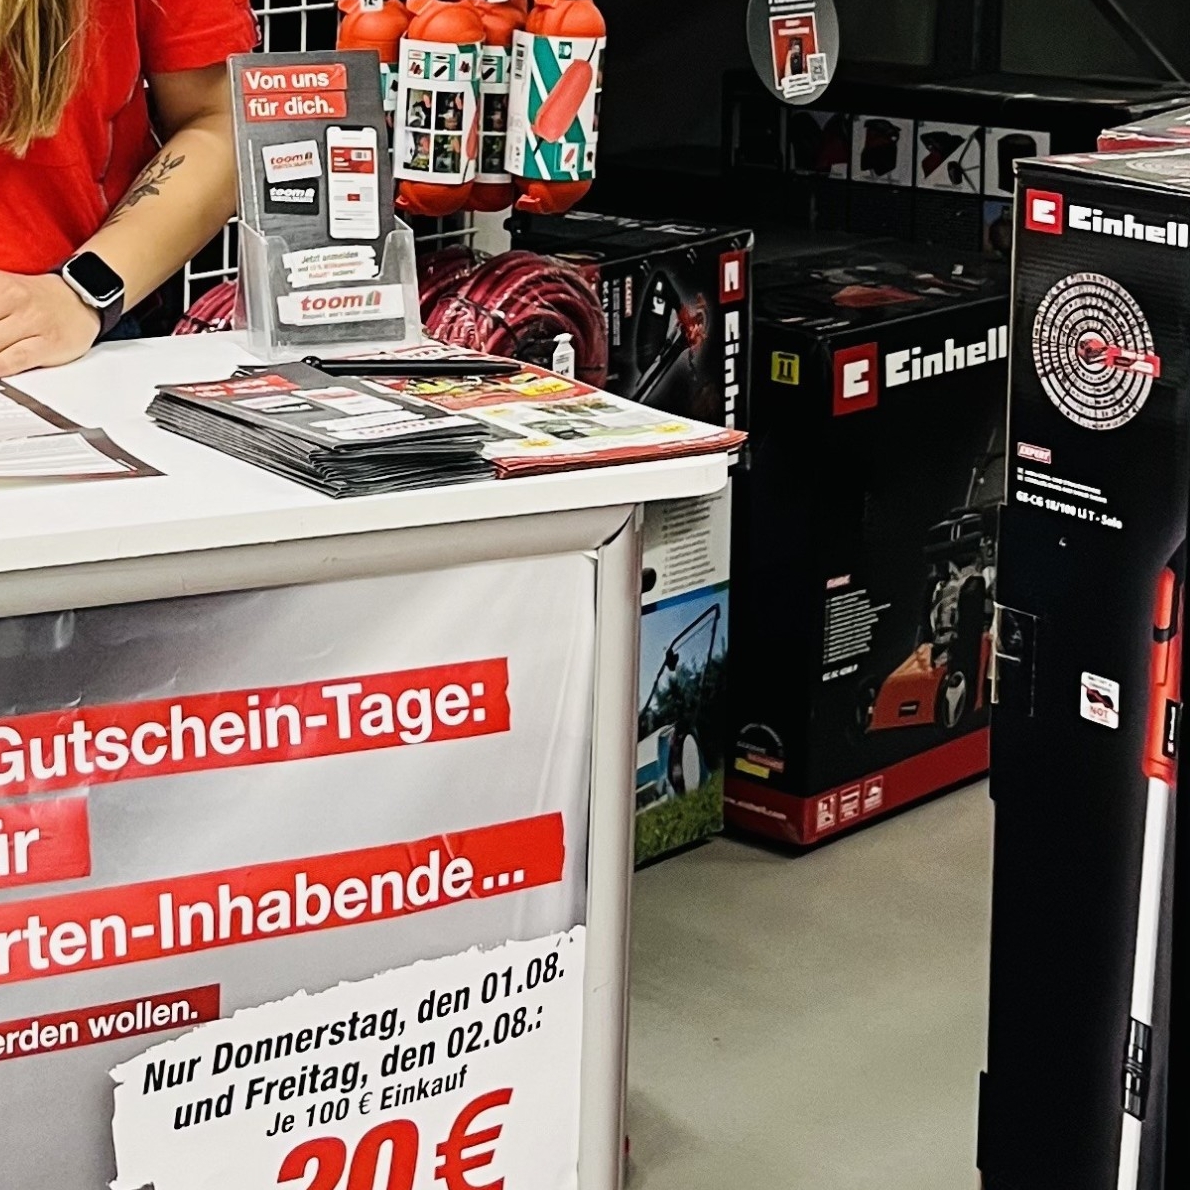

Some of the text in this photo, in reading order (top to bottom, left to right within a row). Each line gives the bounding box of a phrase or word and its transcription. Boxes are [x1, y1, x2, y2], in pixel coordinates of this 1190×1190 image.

[245, 71, 329, 90] Von uns
[248, 95, 335, 117] für dich.
[270, 153, 303, 165] toom
[1068, 204, 1189, 249] Einhell
[301, 294, 364, 311] toom
[885, 325, 1008, 388] Einhell
[88, 997, 199, 1038] wollen.
[142, 952, 566, 1096] Nur Donnerstag, den 01.08.
[173, 1005, 543, 1131] und Freitag, den 02.08.:
[266, 1066, 469, 1138] Je 100 € Einkauf
[435, 1087, 514, 1190] €
